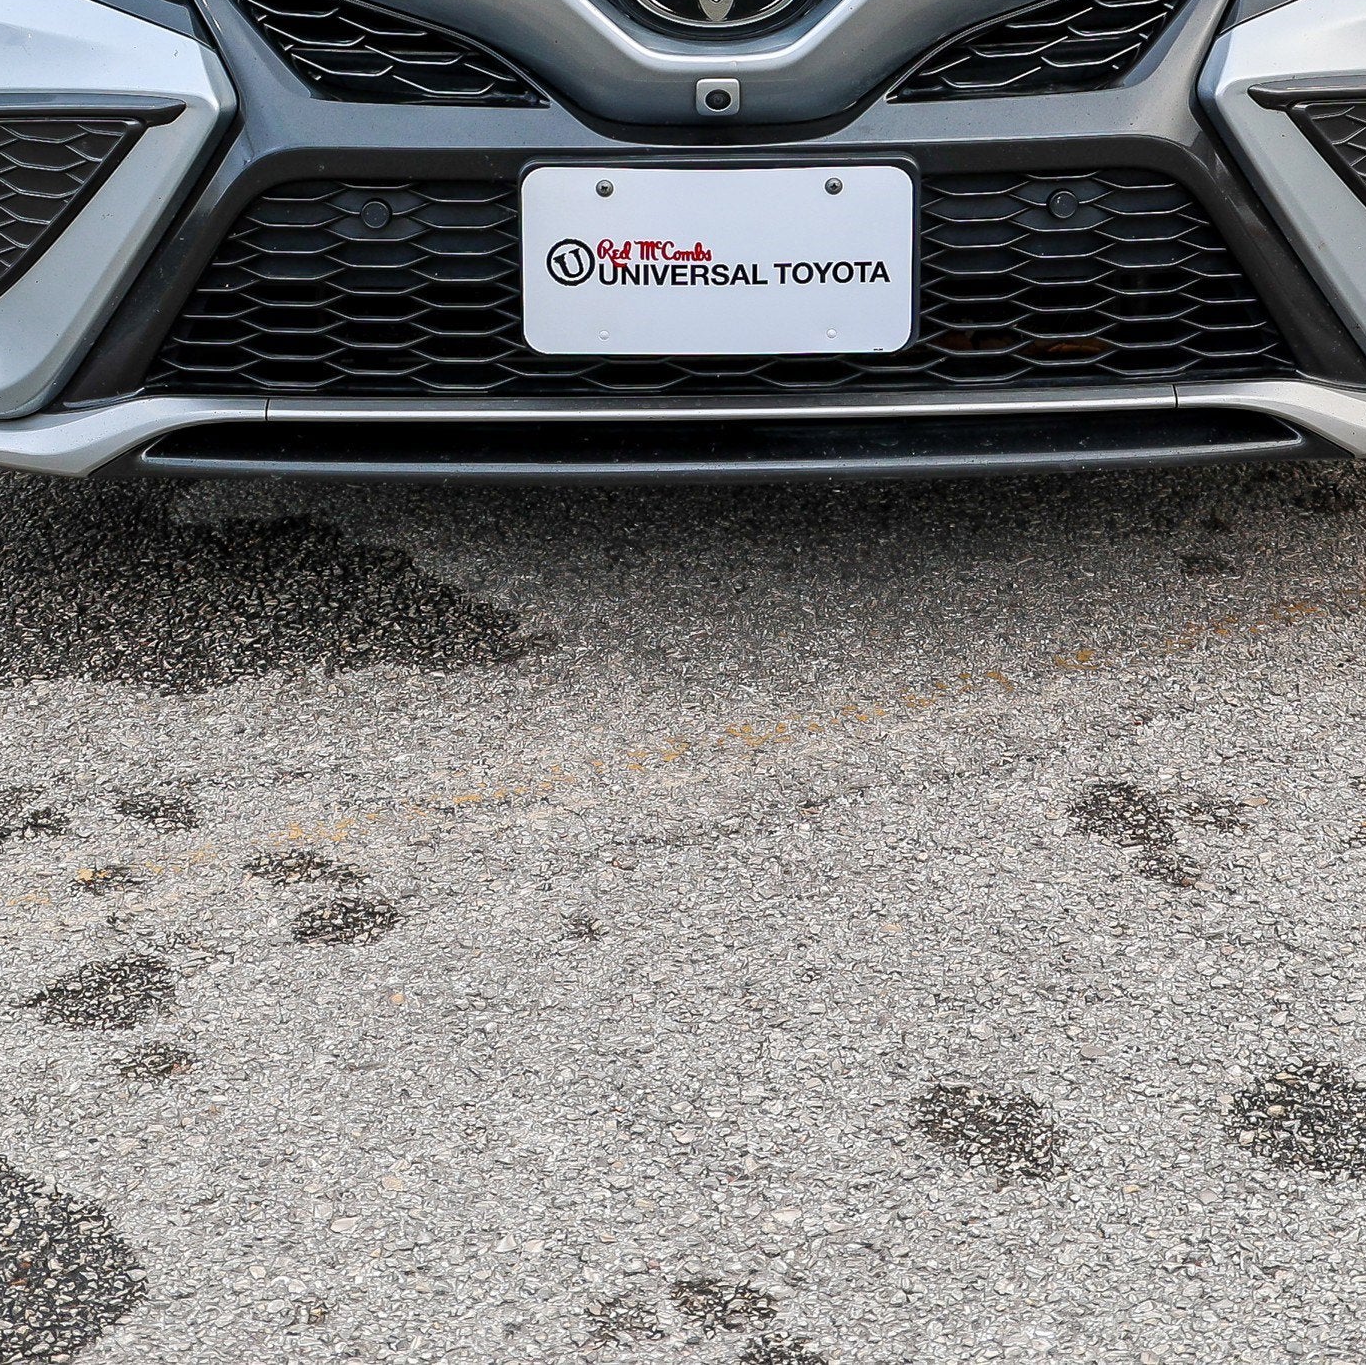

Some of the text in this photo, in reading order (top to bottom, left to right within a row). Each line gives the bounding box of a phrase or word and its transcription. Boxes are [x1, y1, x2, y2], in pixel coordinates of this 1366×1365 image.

[597, 238, 713, 268] Red McCombs
[598, 260, 891, 287] UNIVERSAL TOYOTA
